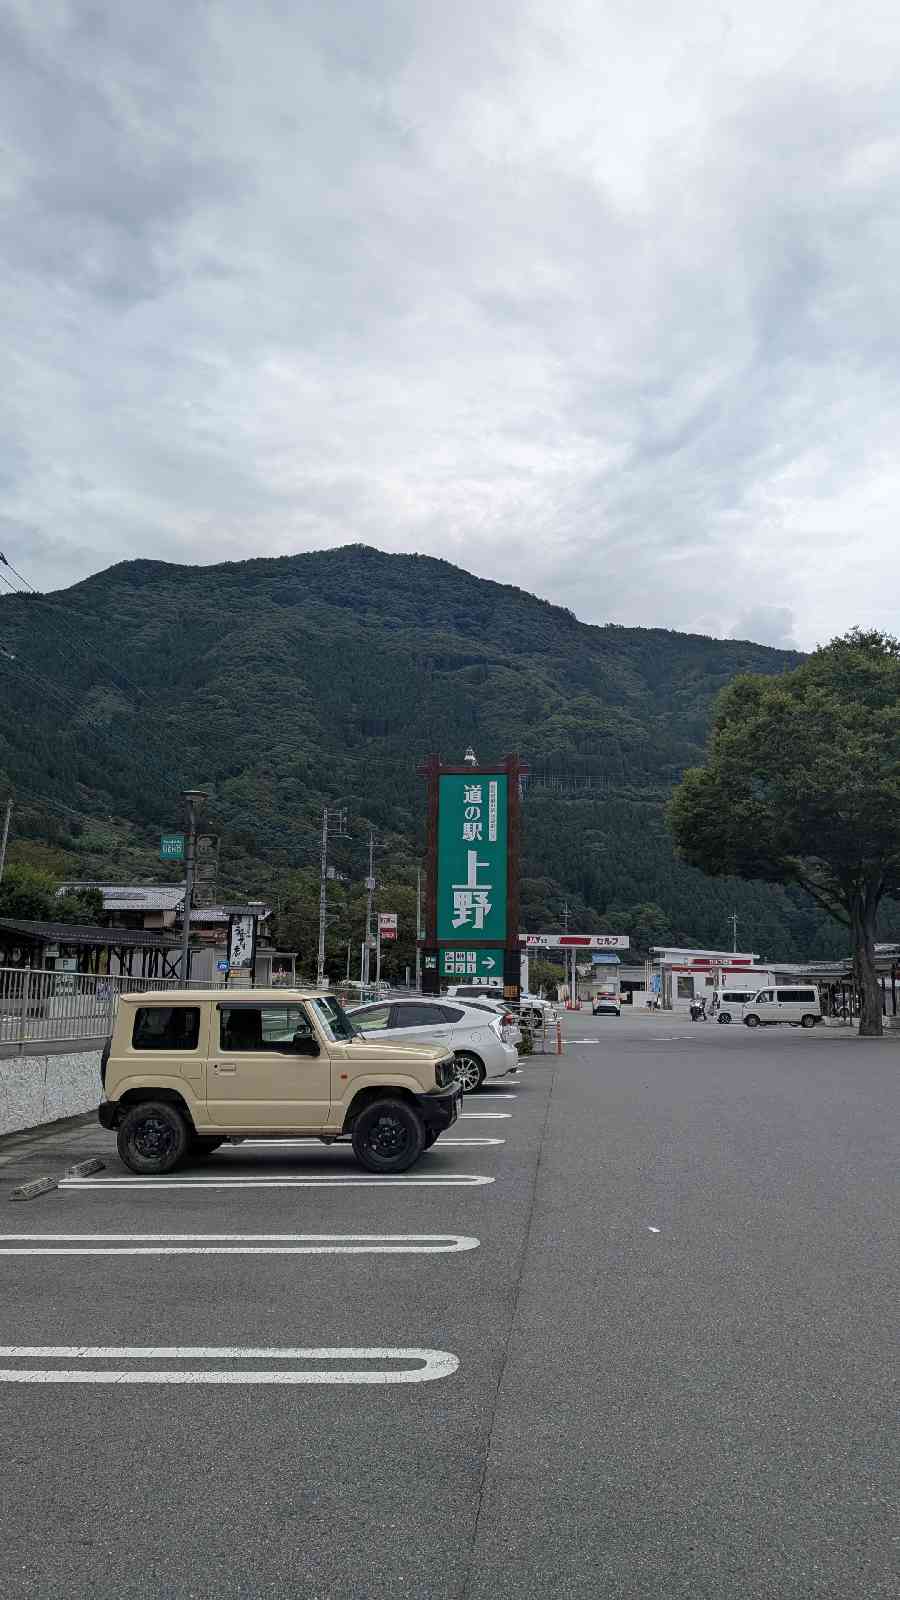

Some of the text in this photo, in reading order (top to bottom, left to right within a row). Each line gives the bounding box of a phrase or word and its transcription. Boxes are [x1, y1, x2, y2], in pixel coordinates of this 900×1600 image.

[451, 784, 493, 929] 道の駅 上野
[596, 937, 619, 945] セルフ
